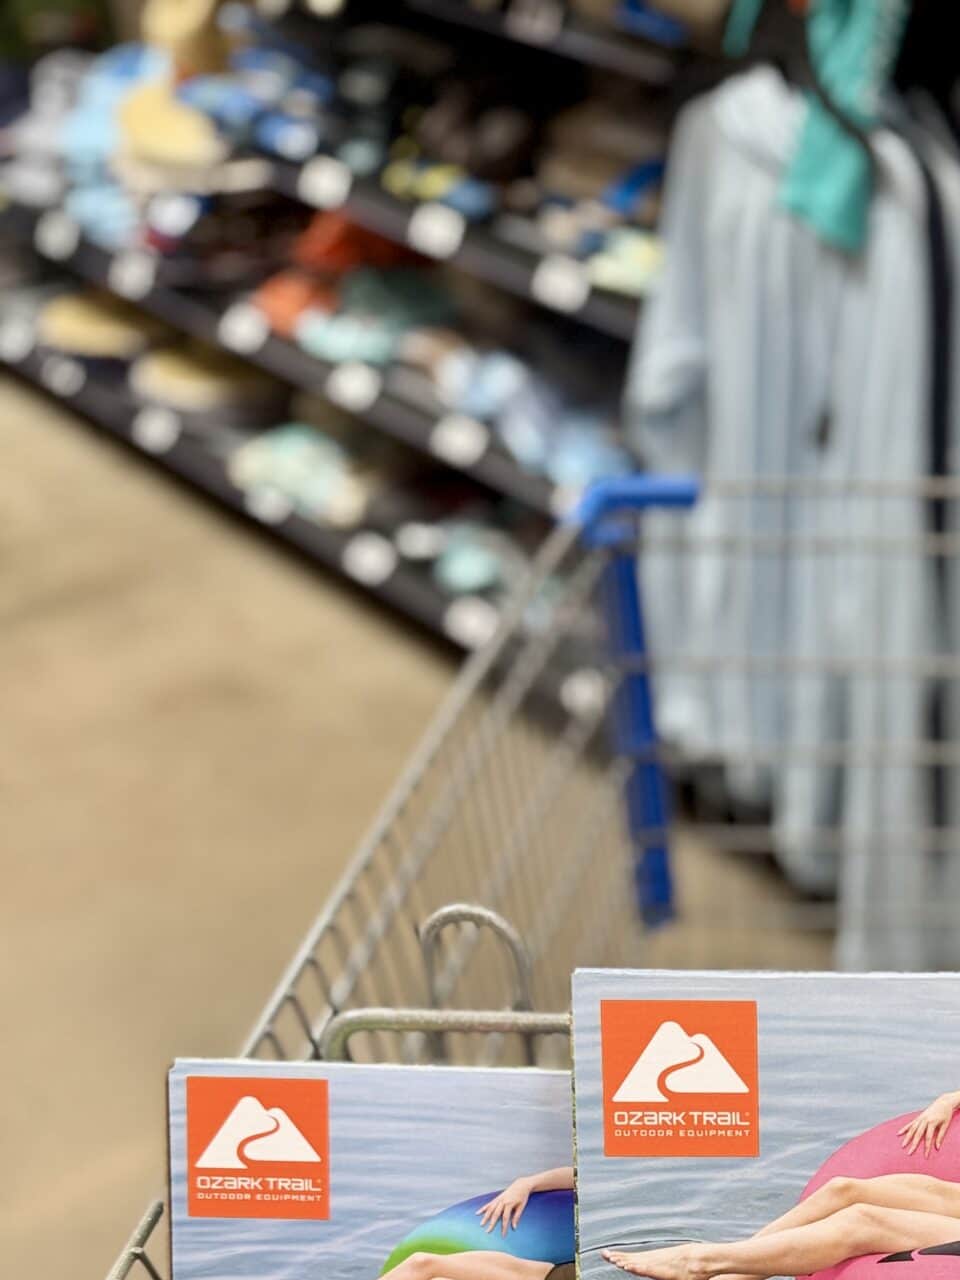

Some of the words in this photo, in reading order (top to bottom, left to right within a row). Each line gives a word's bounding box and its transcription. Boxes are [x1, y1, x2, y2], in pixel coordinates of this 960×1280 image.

[614, 1111, 686, 1126] OZARK
[689, 1111, 750, 1126] TRAIL
[614, 1129, 674, 1137] OUTDOOR
[679, 1129, 751, 1137] EQUIPMENT
[196, 1176, 263, 1190] OZARK
[265, 1178, 322, 1192] TRAIL
[197, 1192, 251, 1200] OUTDOOR
[256, 1193, 322, 1202] EQUIPMENT
